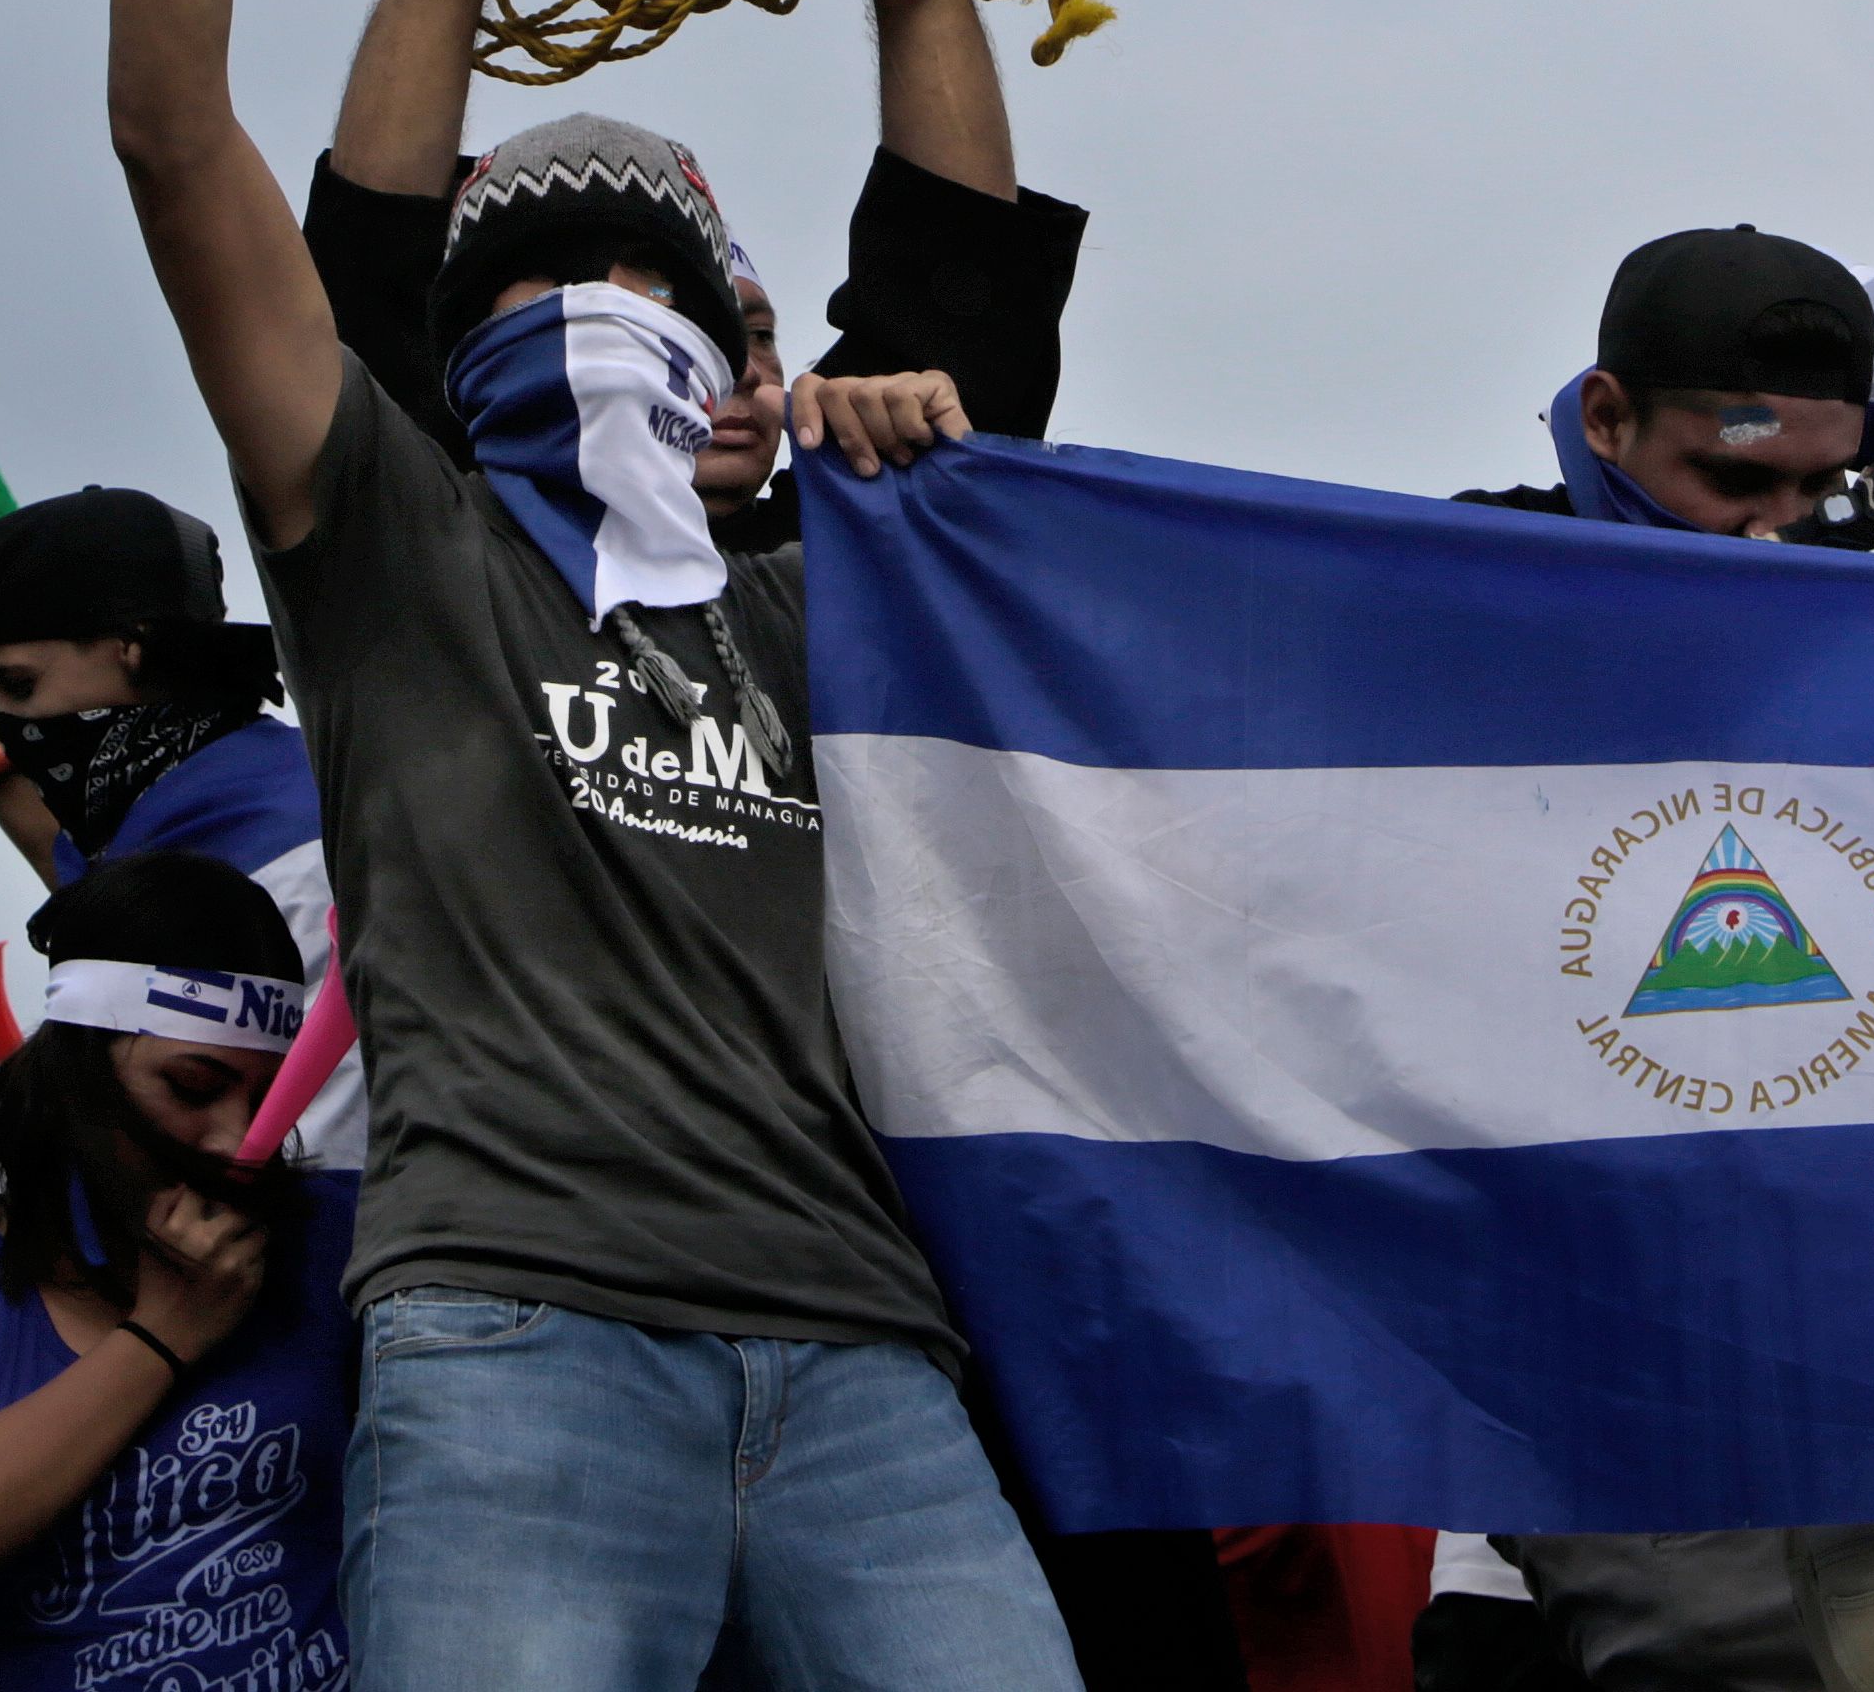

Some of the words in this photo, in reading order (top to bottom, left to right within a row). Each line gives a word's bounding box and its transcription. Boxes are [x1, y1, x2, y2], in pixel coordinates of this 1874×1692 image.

[569, 776, 607, 814] 20
[608, 796, 748, 849] Aniversario
[669, 789, 699, 806] DE
[715, 795, 820, 831] MANAGUA
[177, 1400, 256, 1456] Soy
[232, 1540, 284, 1577] eso
[217, 1584, 293, 1646] me
